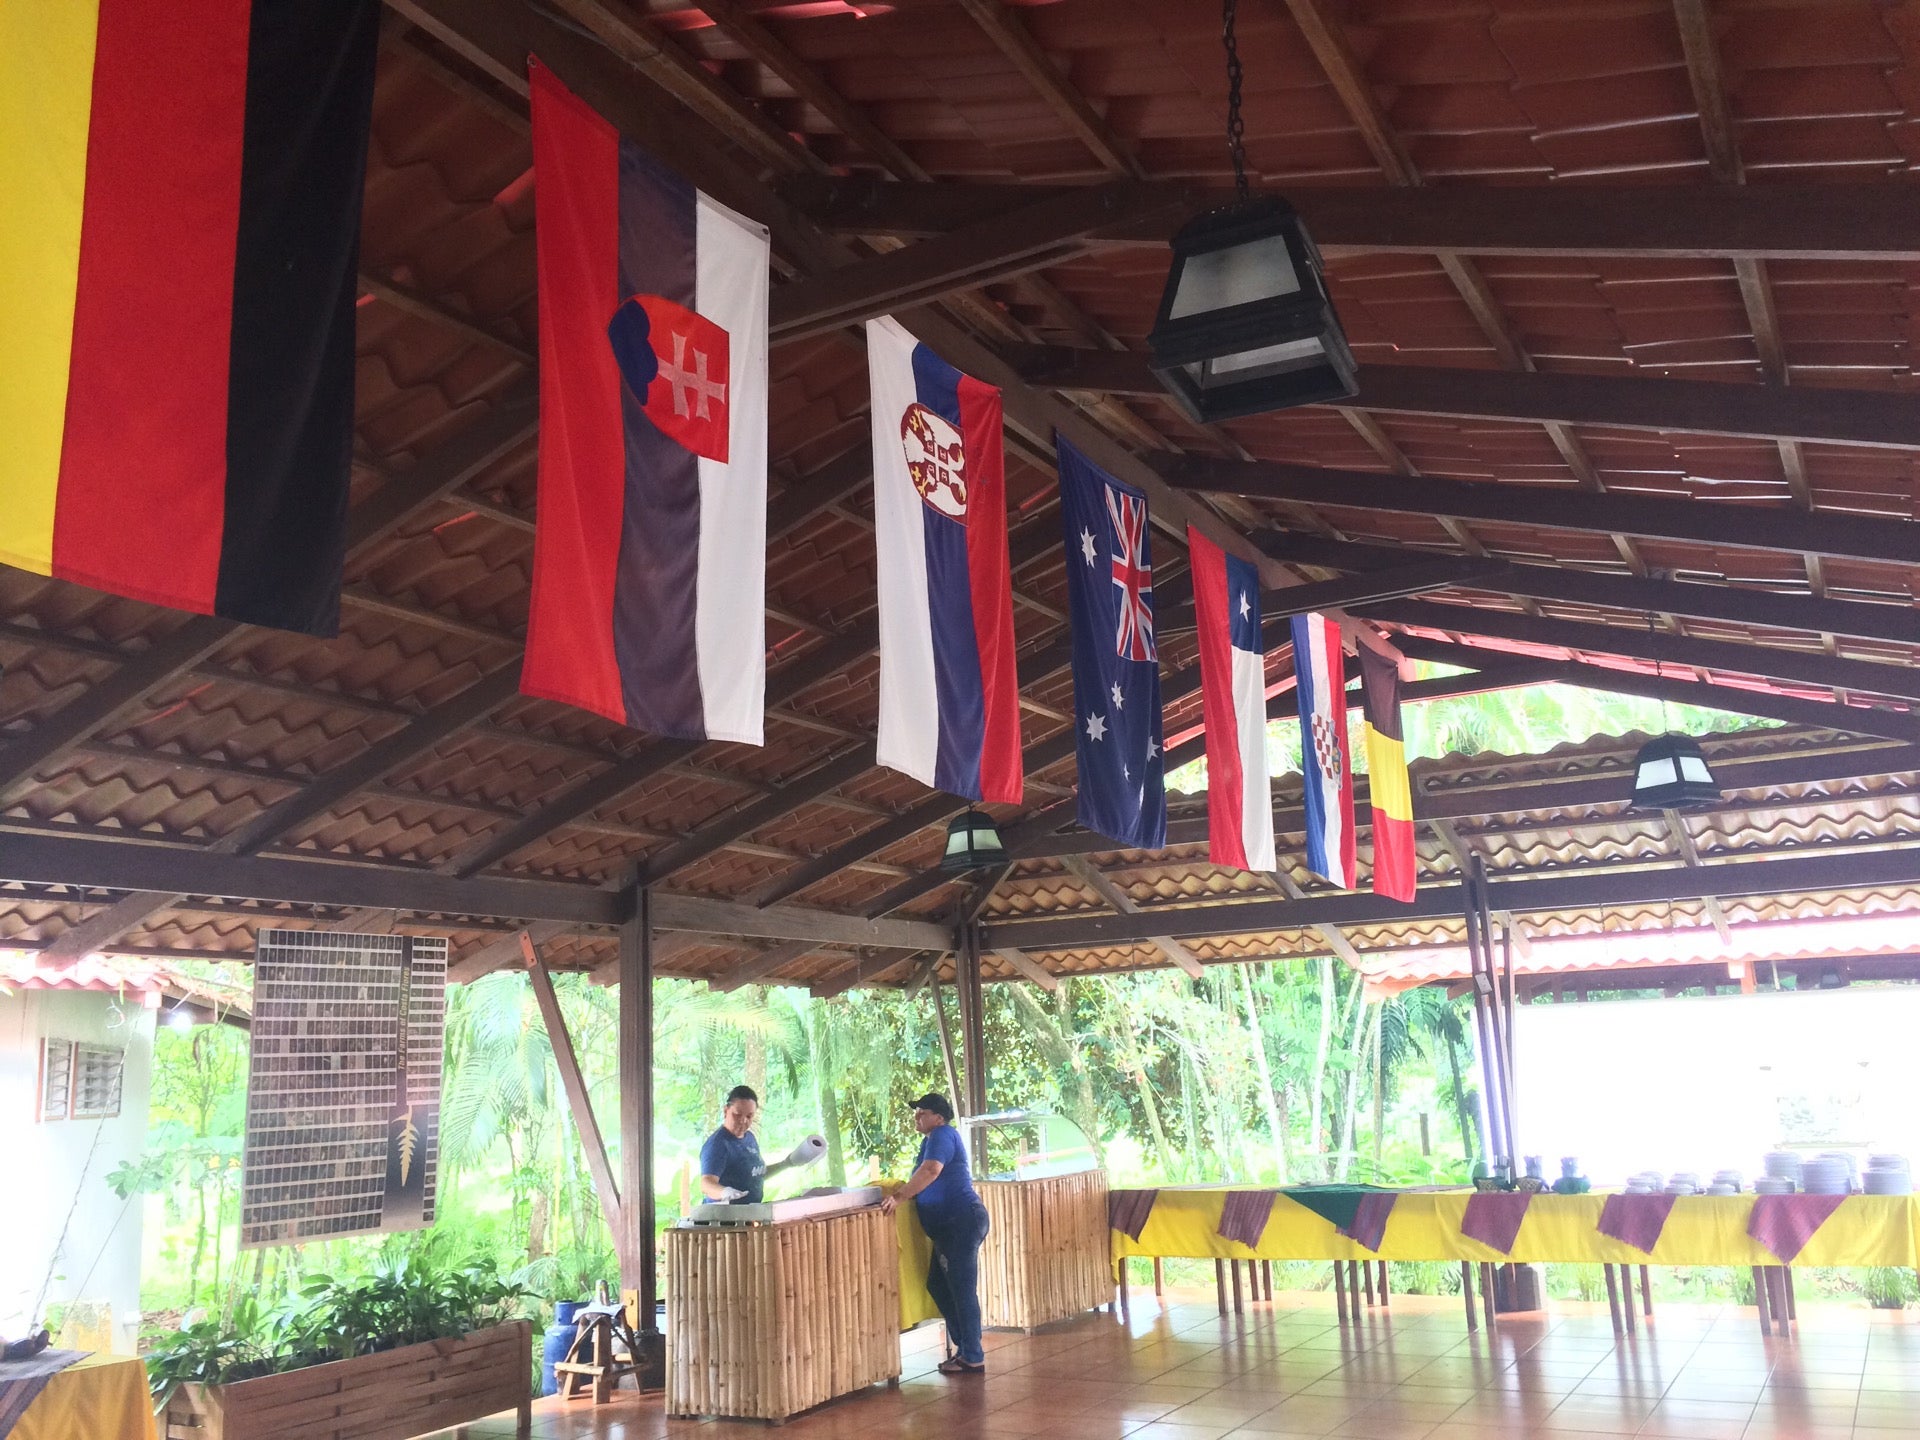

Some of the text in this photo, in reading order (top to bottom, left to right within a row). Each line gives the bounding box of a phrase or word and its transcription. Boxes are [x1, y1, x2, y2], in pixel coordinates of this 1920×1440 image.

[398, 967, 410, 1070] The Farms of Costa Flores
